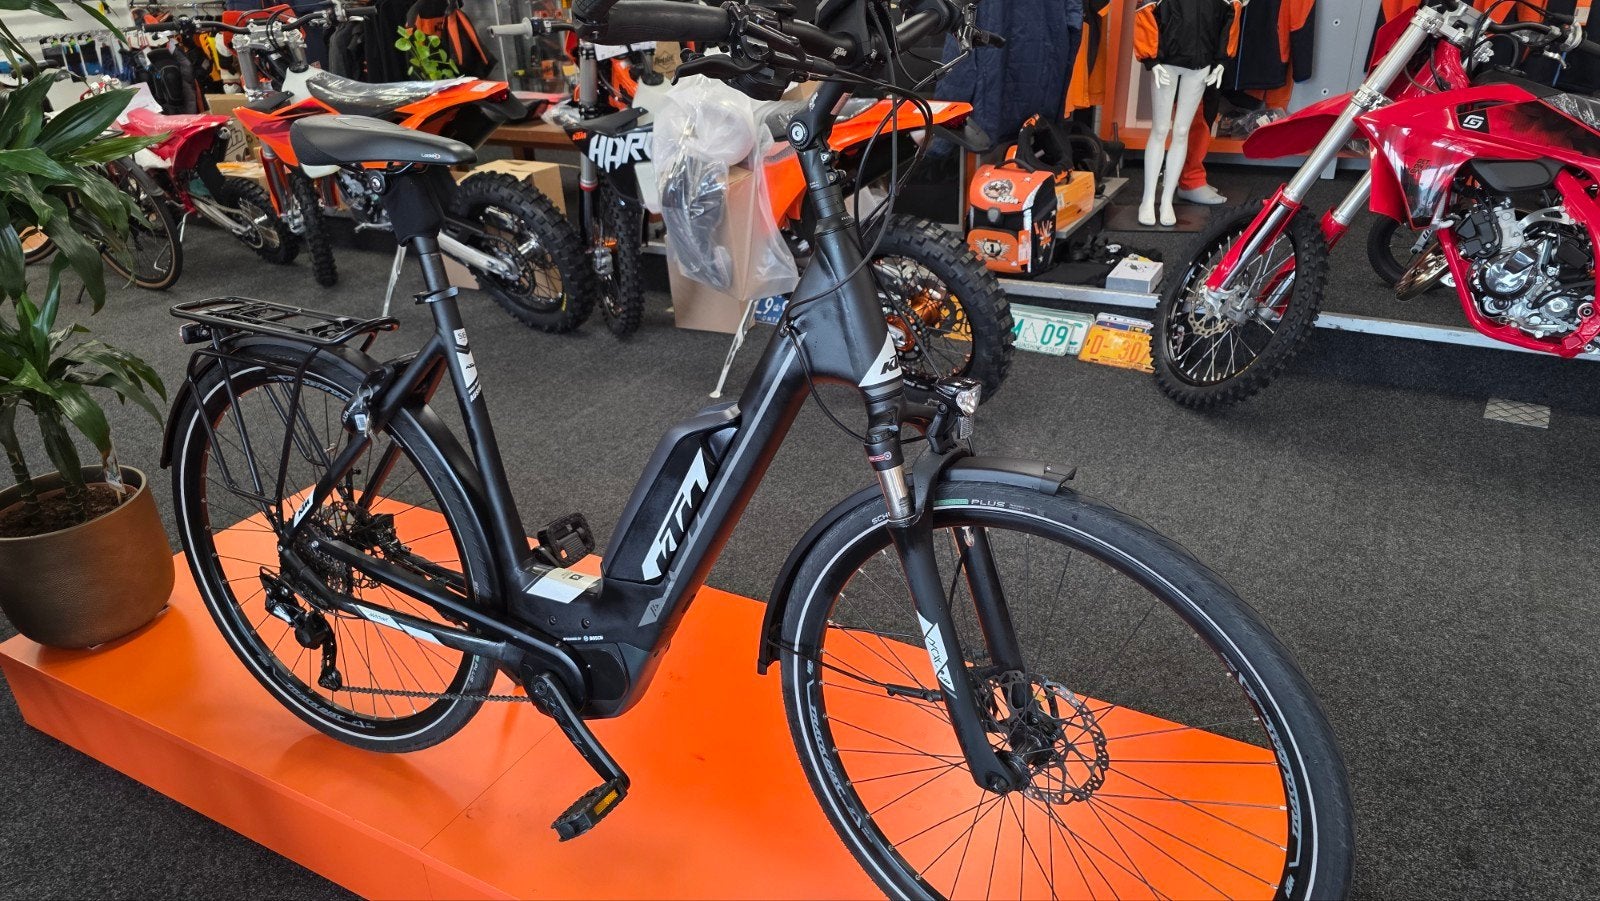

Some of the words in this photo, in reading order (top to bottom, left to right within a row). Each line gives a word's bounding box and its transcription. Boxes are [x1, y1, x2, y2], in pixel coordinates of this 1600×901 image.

[1040, 323, 1069, 347] 09
[641, 446, 709, 581] KTM
[970, 498, 1006, 508] PLUS
